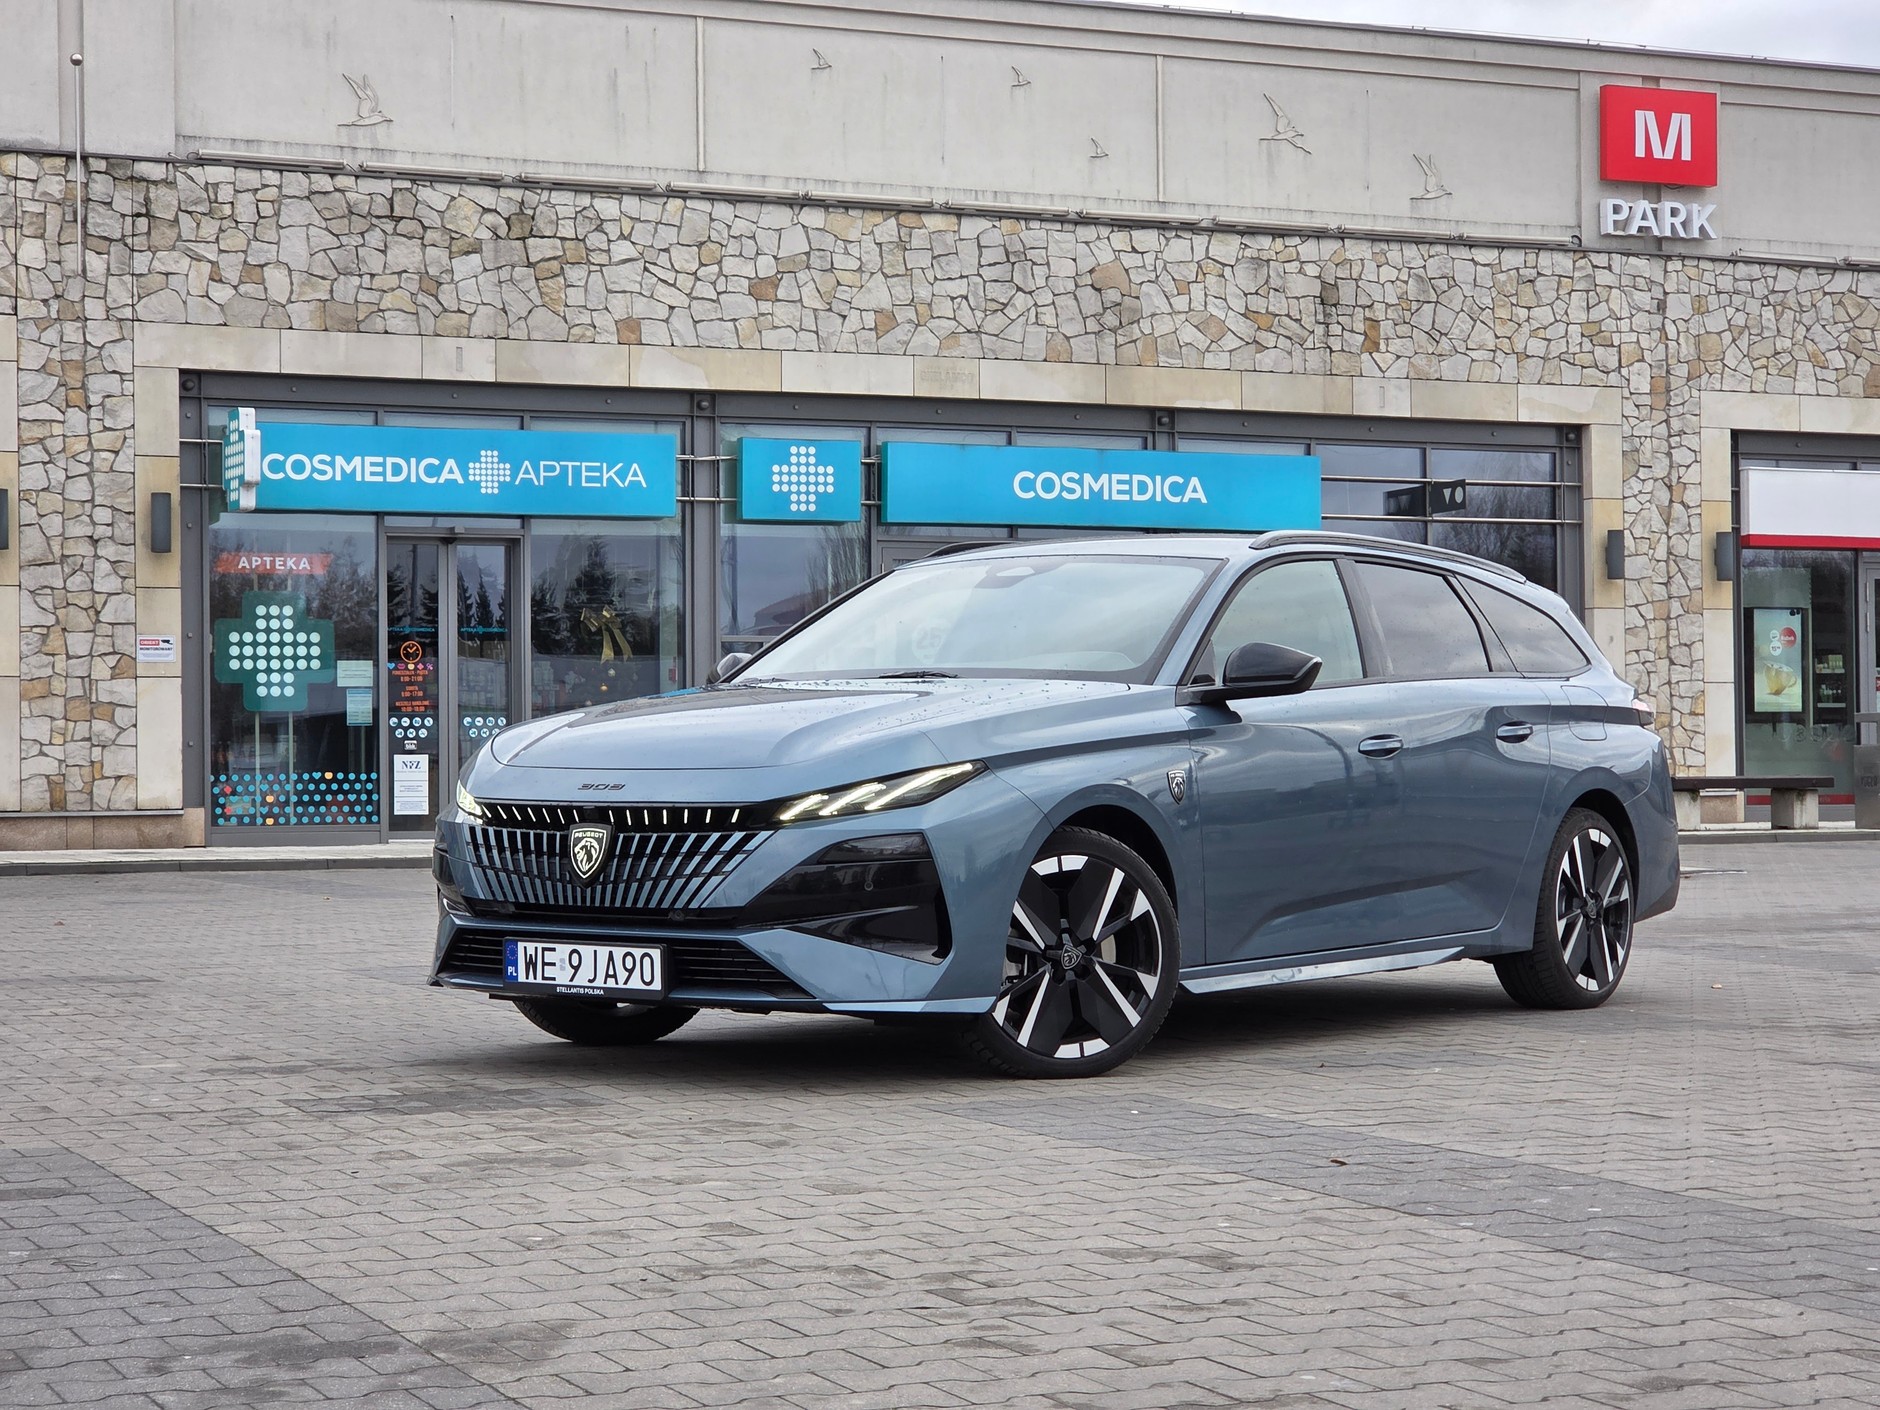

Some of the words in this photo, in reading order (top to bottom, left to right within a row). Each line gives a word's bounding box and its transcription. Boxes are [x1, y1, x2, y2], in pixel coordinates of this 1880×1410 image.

[1635, 110, 1691, 161] M
[1600, 198, 1717, 240] PARK
[262, 453, 464, 484] COSMEDICA
[515, 460, 647, 488] APTEKA
[1013, 471, 1207, 503] COSMEDICA
[238, 556, 311, 571] APTEKA
[402, 760, 421, 769] NFZ
[577, 783, 626, 791] 308
[574, 831, 604, 839] PEUGEOT
[507, 966, 517, 976] PL
[523, 946, 557, 982] WE
[568, 948, 654, 987] 9JA90
[556, 986, 584, 994] STELLANTIS
[585, 987, 604, 995] POLSKA
